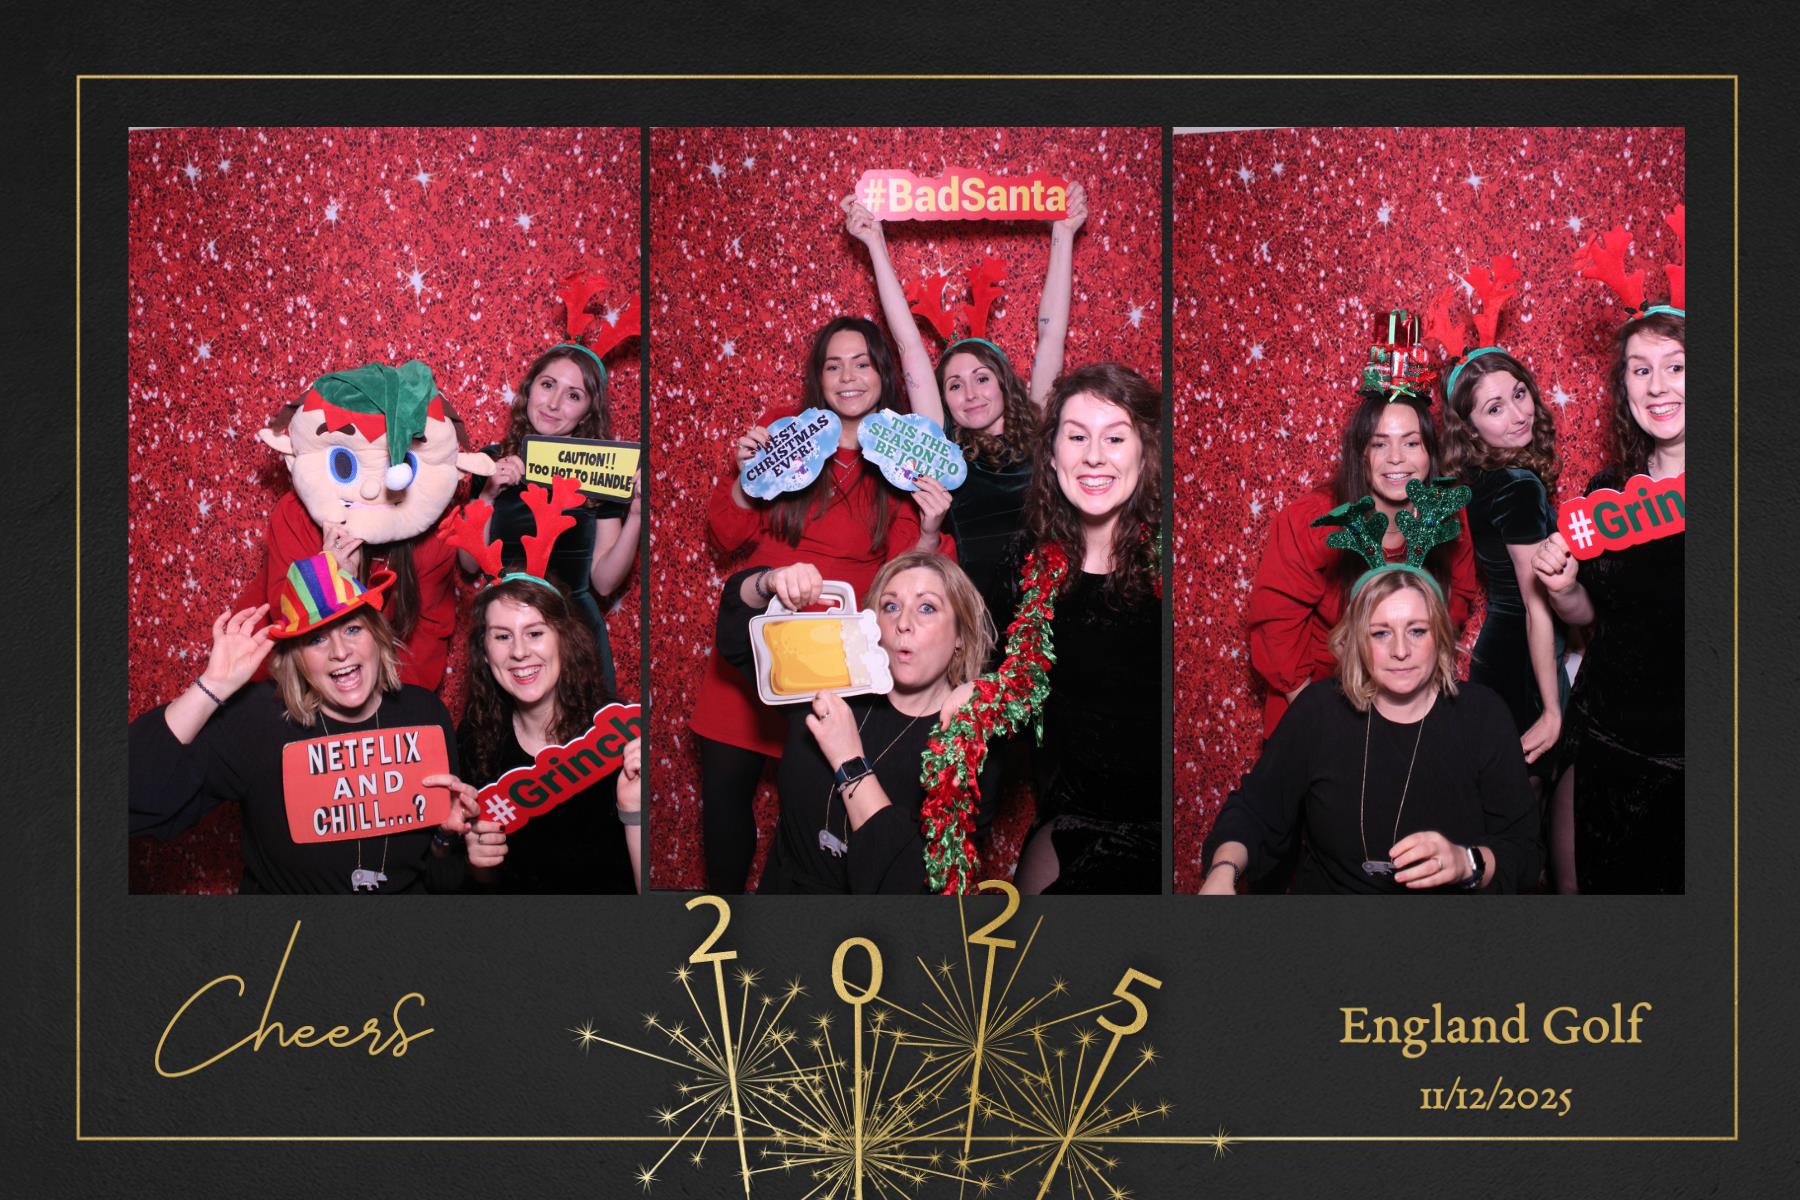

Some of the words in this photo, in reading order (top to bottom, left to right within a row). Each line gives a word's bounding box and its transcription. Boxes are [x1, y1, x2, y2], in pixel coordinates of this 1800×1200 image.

[862, 175, 1066, 213] #BadSanta
[746, 414, 829, 481] CHRISTMAS
[765, 421, 798, 455] BEST
[869, 422, 936, 463] SEASON
[938, 457, 959, 475] TO
[874, 440, 896, 459] BE
[891, 417, 918, 439] TIS
[920, 431, 951, 457] THE
[528, 463, 549, 476] TOO
[551, 465, 573, 479] HOT
[574, 469, 588, 483] TO
[589, 471, 632, 492] HANDLE
[558, 450, 616, 470] CAUTION!!
[772, 441, 814, 477] EVER!
[1568, 487, 1685, 549] #Grin
[307, 731, 421, 775] NETFLIX
[333, 770, 404, 800] AND
[313, 794, 426, 836] CHILL...?
